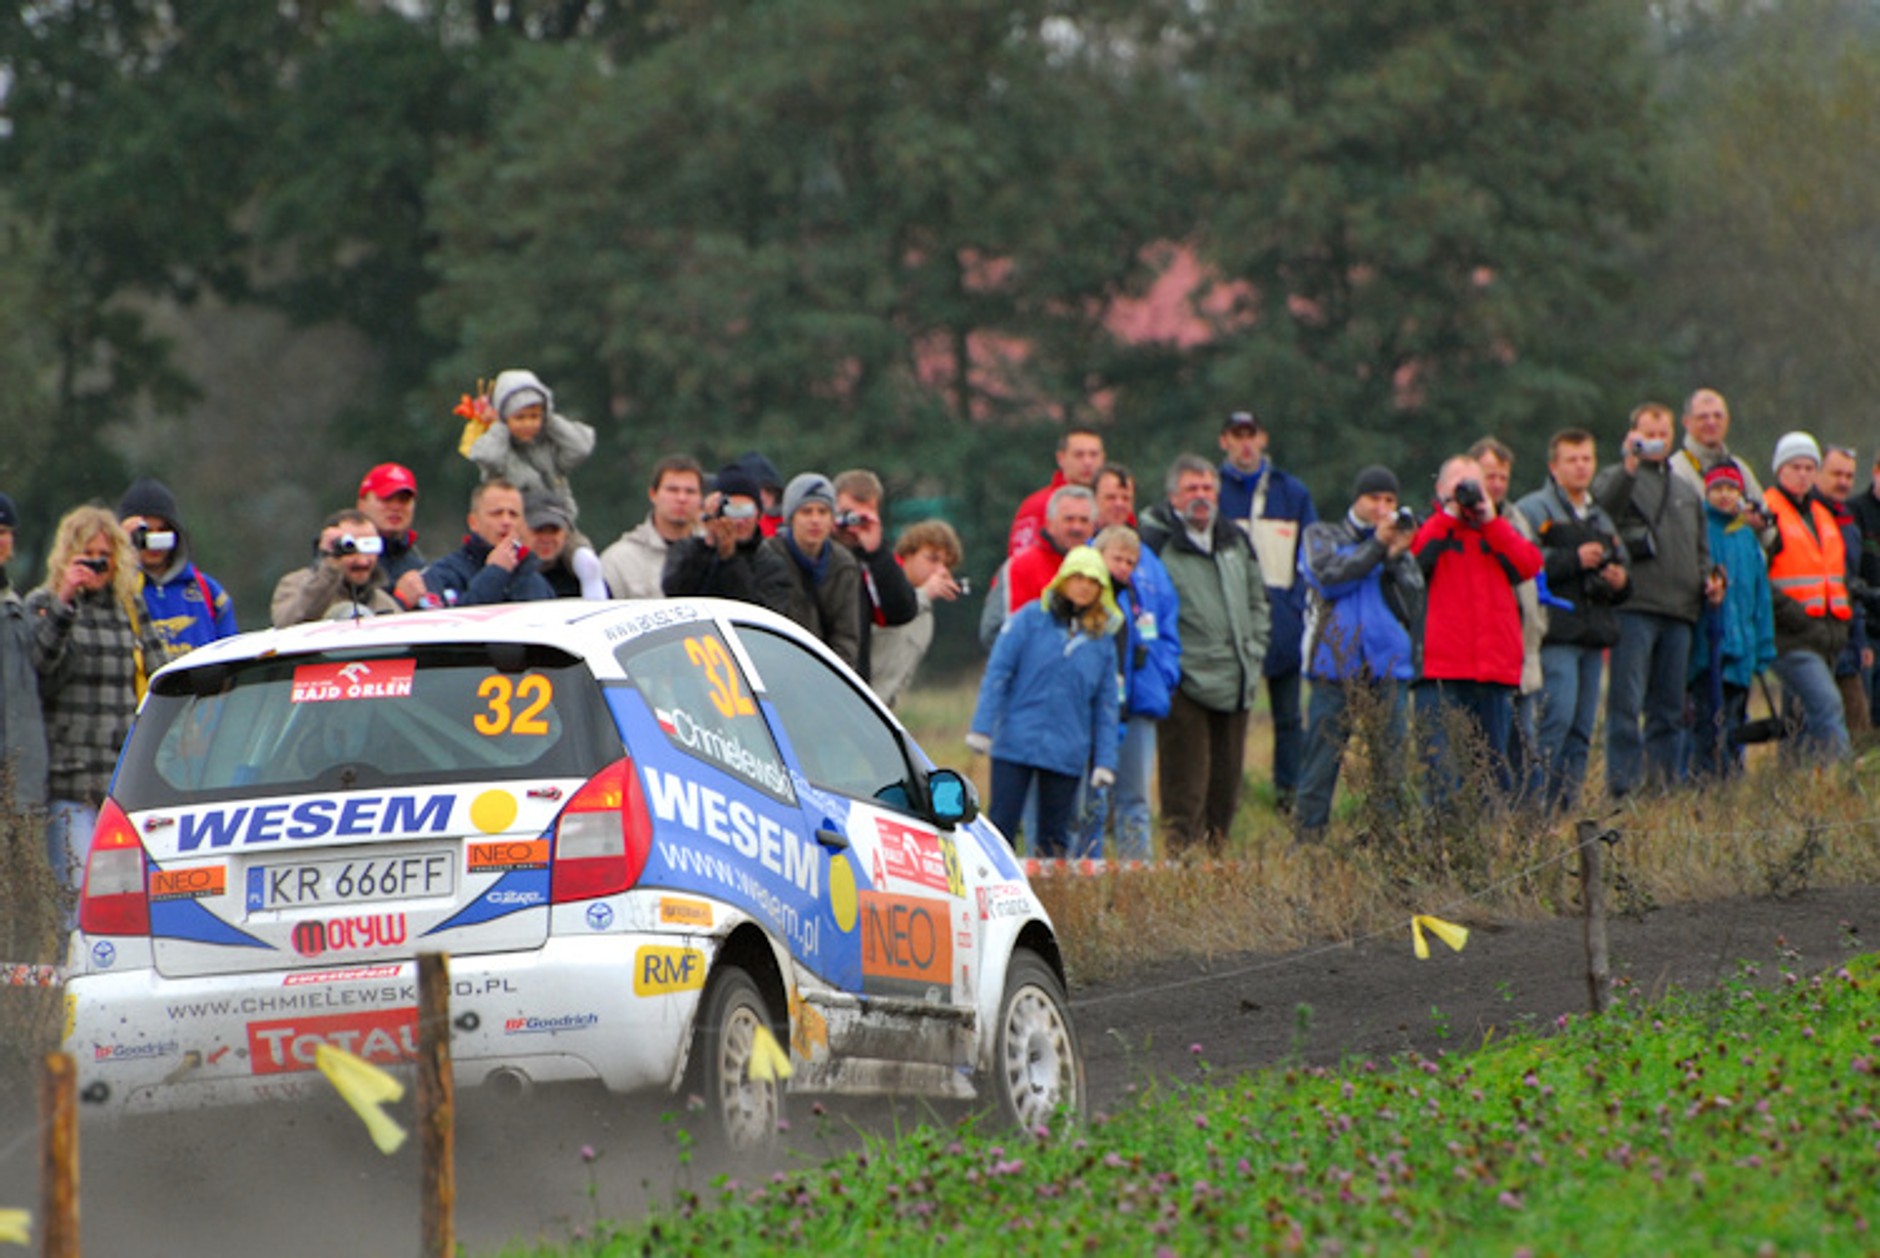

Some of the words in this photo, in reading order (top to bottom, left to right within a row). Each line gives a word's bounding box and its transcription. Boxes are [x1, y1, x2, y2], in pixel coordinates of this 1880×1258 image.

[292, 685, 340, 701] RAJD
[346, 682, 411, 699] ORLEN
[684, 634, 756, 718] 32
[473, 673, 553, 736] 32
[177, 794, 457, 853] WESEM
[643, 766, 820, 900] WESEM
[472, 844, 533, 864] NEO
[156, 868, 211, 891] NEO
[270, 866, 321, 904] KR
[335, 857, 446, 899] 666FF
[868, 903, 937, 971] NEO
[643, 954, 699, 985] RMF
[504, 1011, 600, 1032] BFGoodrich
